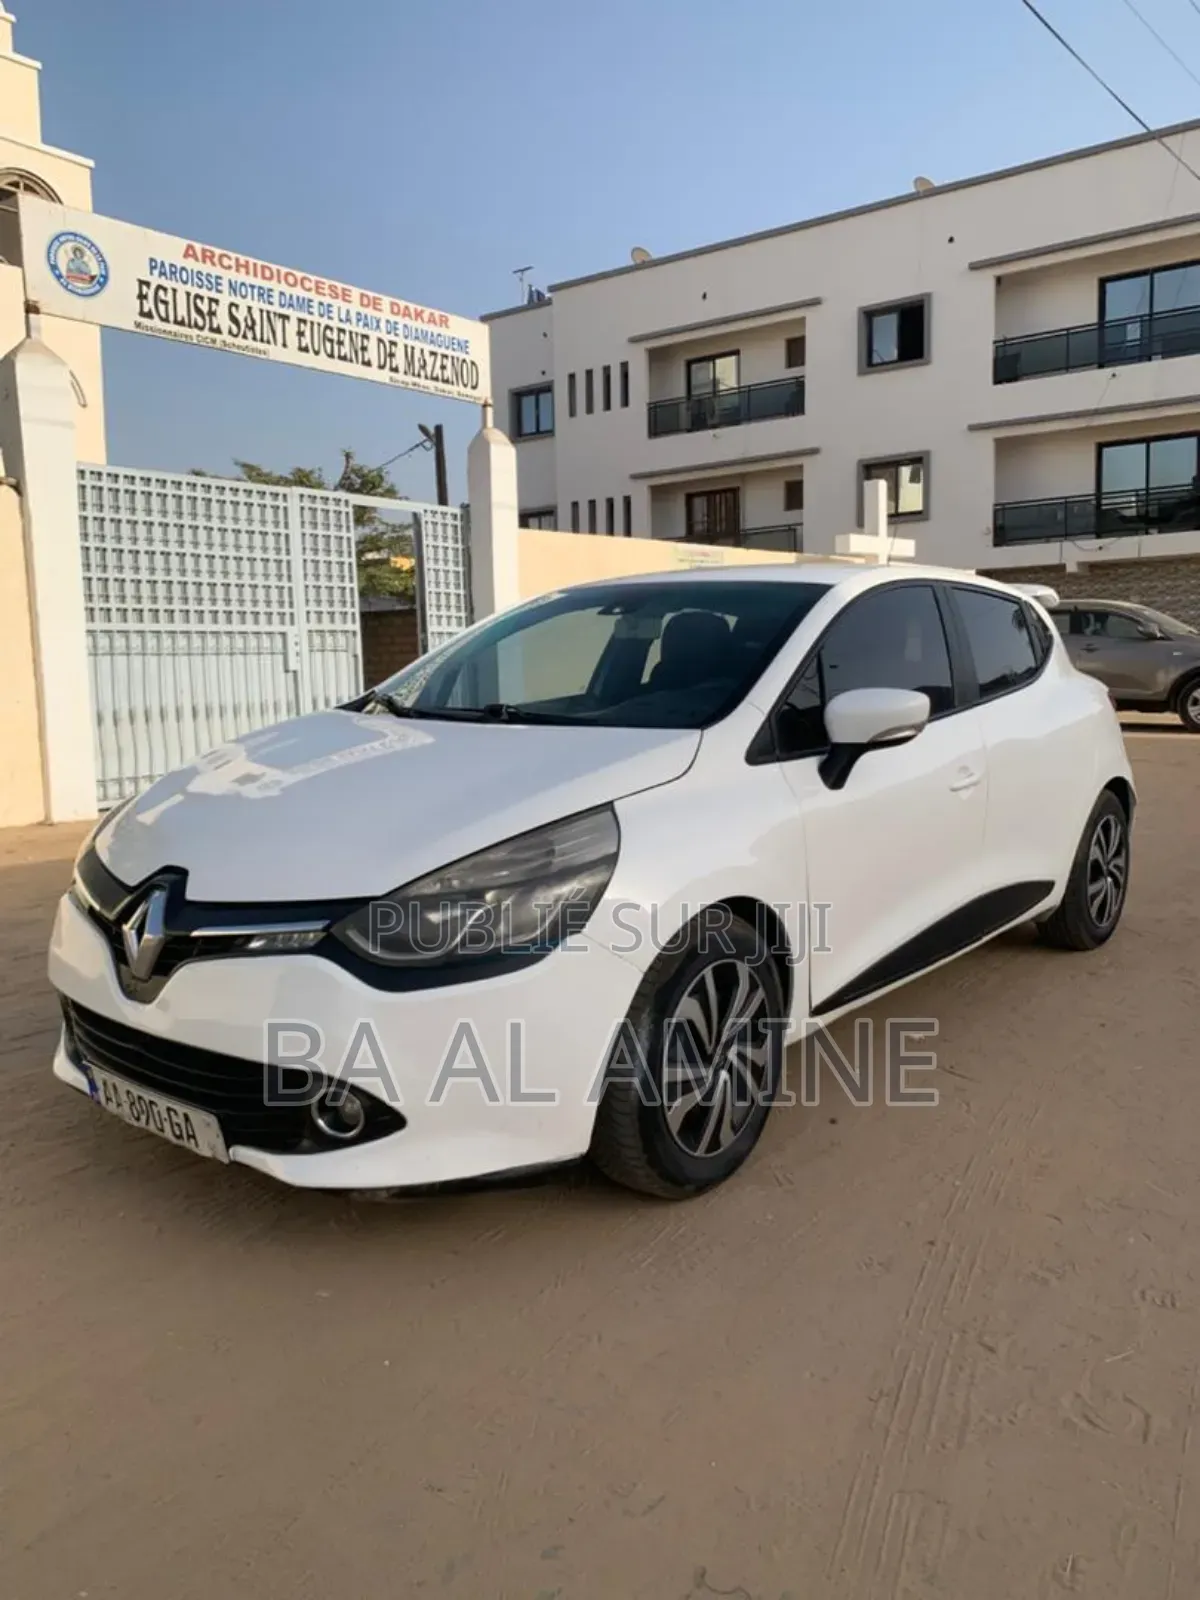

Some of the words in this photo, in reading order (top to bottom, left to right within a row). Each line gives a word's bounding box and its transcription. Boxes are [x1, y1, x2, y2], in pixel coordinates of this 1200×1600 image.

[137, 278, 223, 335] EGLISE
[228, 302, 290, 348] SAINT
[296, 316, 372, 367] EUGENE
[377, 336, 399, 373] DE
[403, 343, 479, 390] MAZENOD
[149, 257, 223, 294] PAROISSE
[228, 279, 273, 305] NOTRE
[278, 291, 314, 315] DAME
[318, 301, 333, 320] DE
[338, 306, 352, 324] LA
[356, 311, 381, 333] PAIX
[386, 319, 399, 337] DE
[403, 324, 469, 354] DIAMAGUENE
[183, 243, 352, 303] ARCHIDIOCESE
[360, 292, 383, 312] DE
[390, 301, 449, 328] DAKAR
